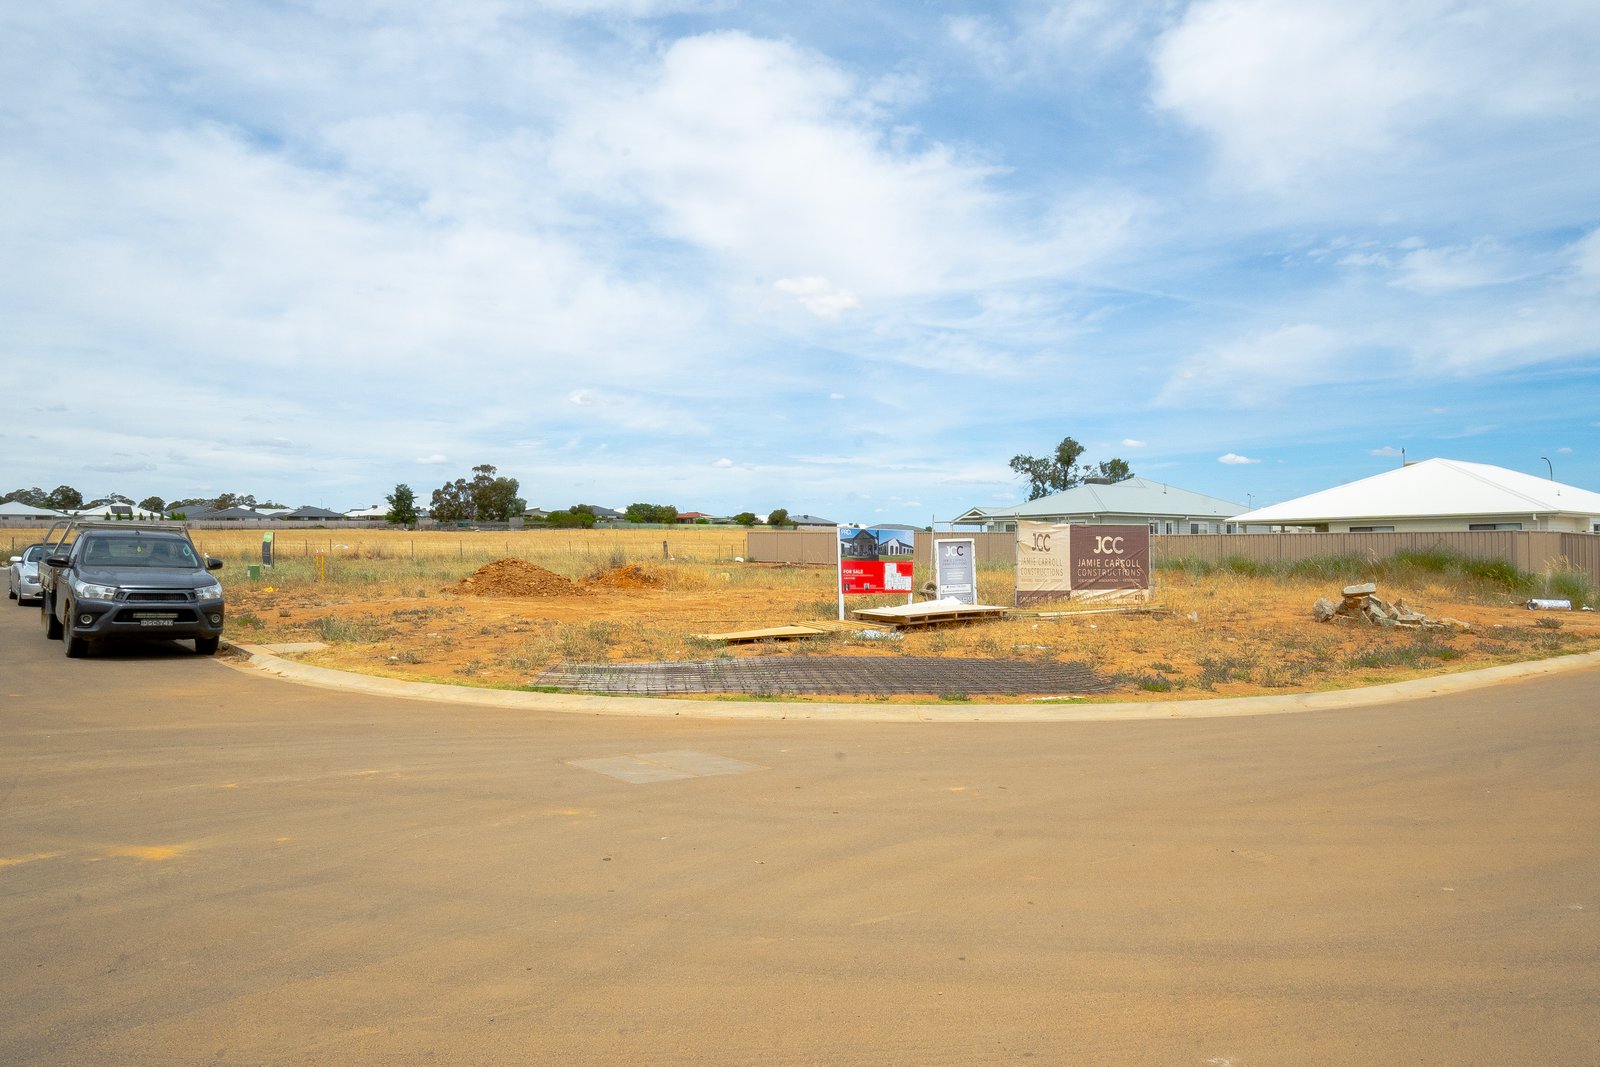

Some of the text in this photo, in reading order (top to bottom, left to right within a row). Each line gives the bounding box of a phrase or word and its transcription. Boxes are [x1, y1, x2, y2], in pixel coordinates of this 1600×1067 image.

[1032, 533, 1051, 552] JCC
[1093, 535, 1124, 554] JCC
[945, 545, 964, 557] JCC
[1020, 557, 1063, 567] JAMIE CARROLL
[1077, 559, 1101, 568] JAMIE
[1020, 567, 1064, 577] CONSTRUCTIONS
[1077, 568, 1141, 577] CONSTRUCTIONS
